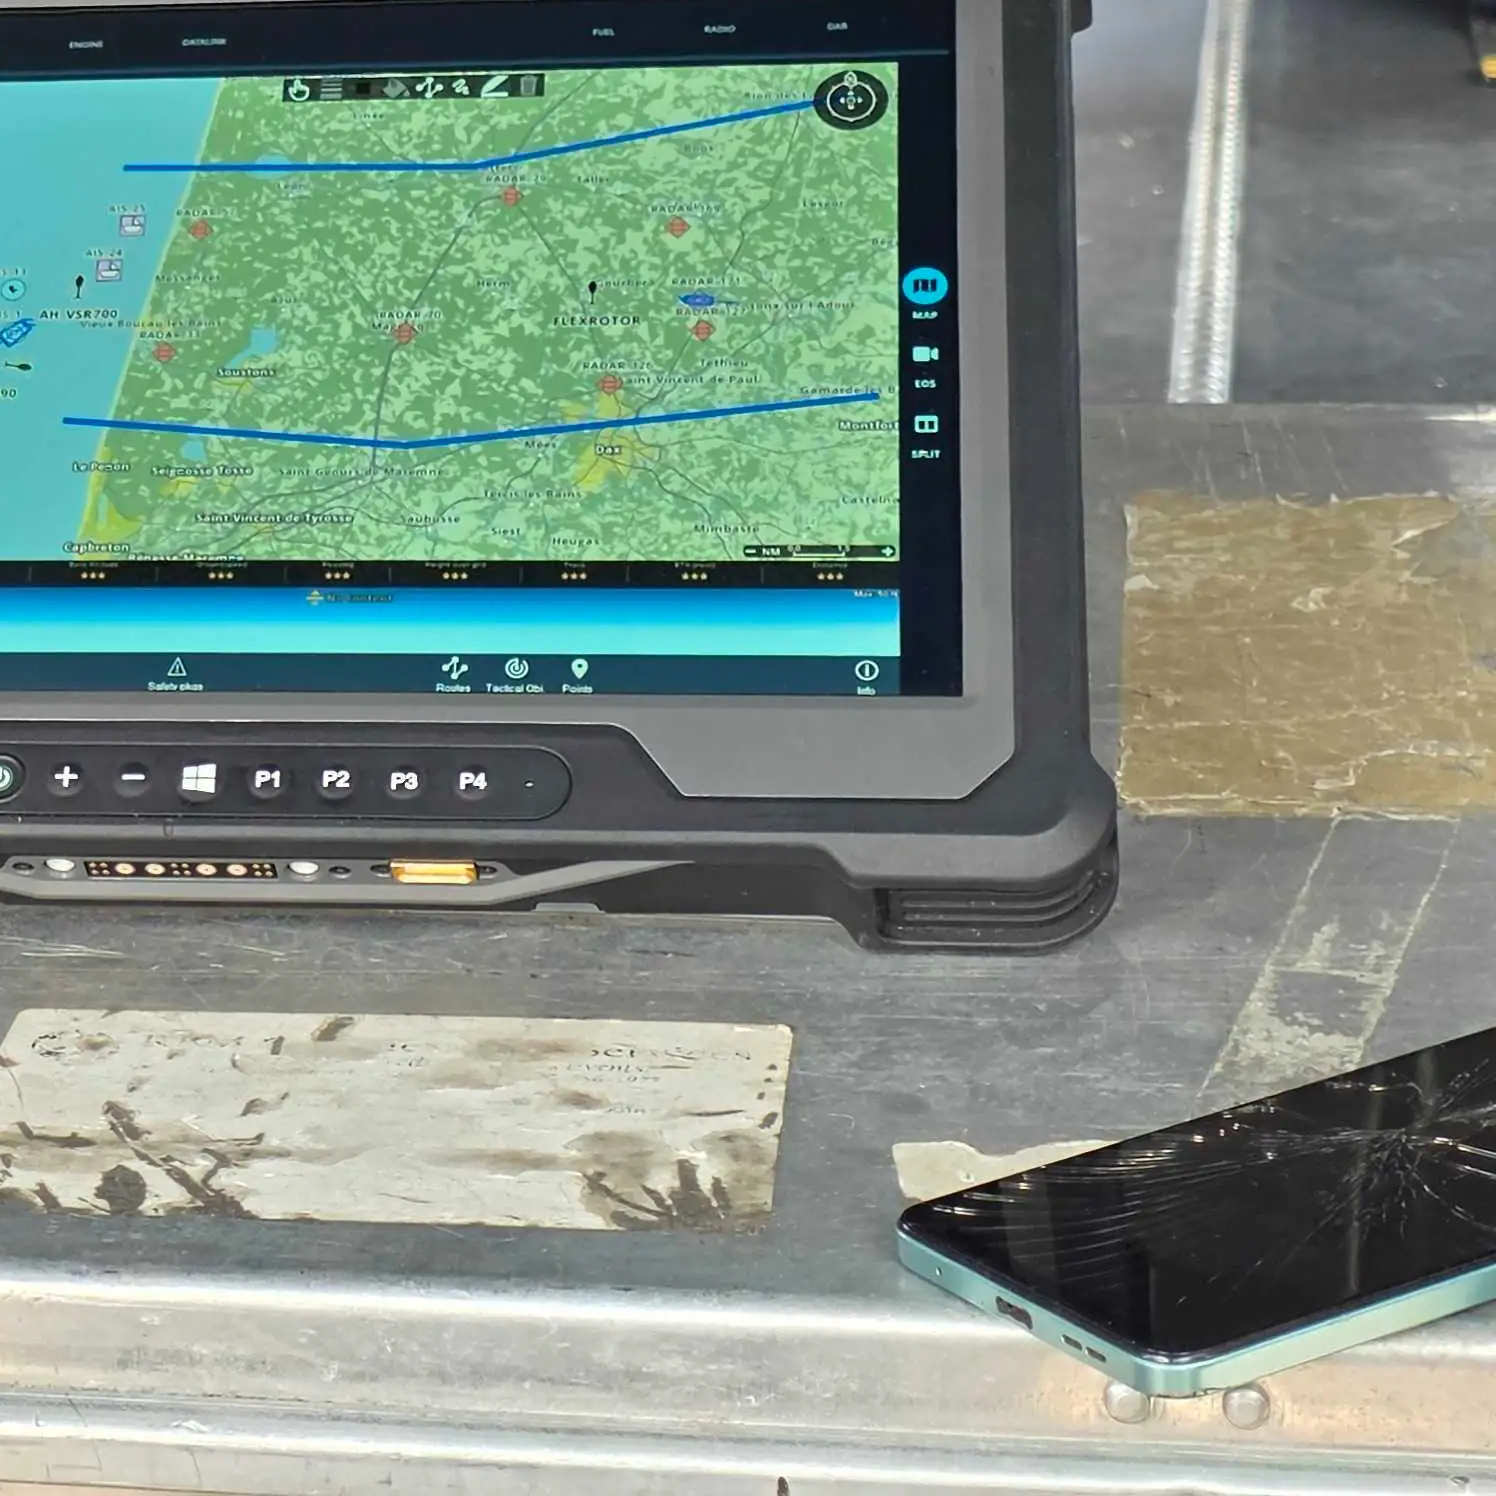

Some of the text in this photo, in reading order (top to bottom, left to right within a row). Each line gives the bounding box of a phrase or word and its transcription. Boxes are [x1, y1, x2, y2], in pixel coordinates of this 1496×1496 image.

[592, 28, 615, 37] FUEL
[704, 24, 736, 34] RADIO
[40, 309, 118, 319] AH VSR700
[554, 316, 640, 326] FLEXROTOR
[914, 379, 936, 388] EOS
[596, 445, 621, 454] Dax
[911, 449, 941, 459] SPLIT
[64, 540, 130, 555] Capbreton
[762, 547, 780, 556] NM
[436, 684, 471, 694] Routes
[486, 684, 523, 694] Tactical
[562, 684, 593, 694] Points
[857, 685, 877, 695] Info
[254, 770, 281, 789] P1
[322, 770, 350, 789] P2
[390, 771, 418, 790] P3
[459, 771, 488, 791] P4
